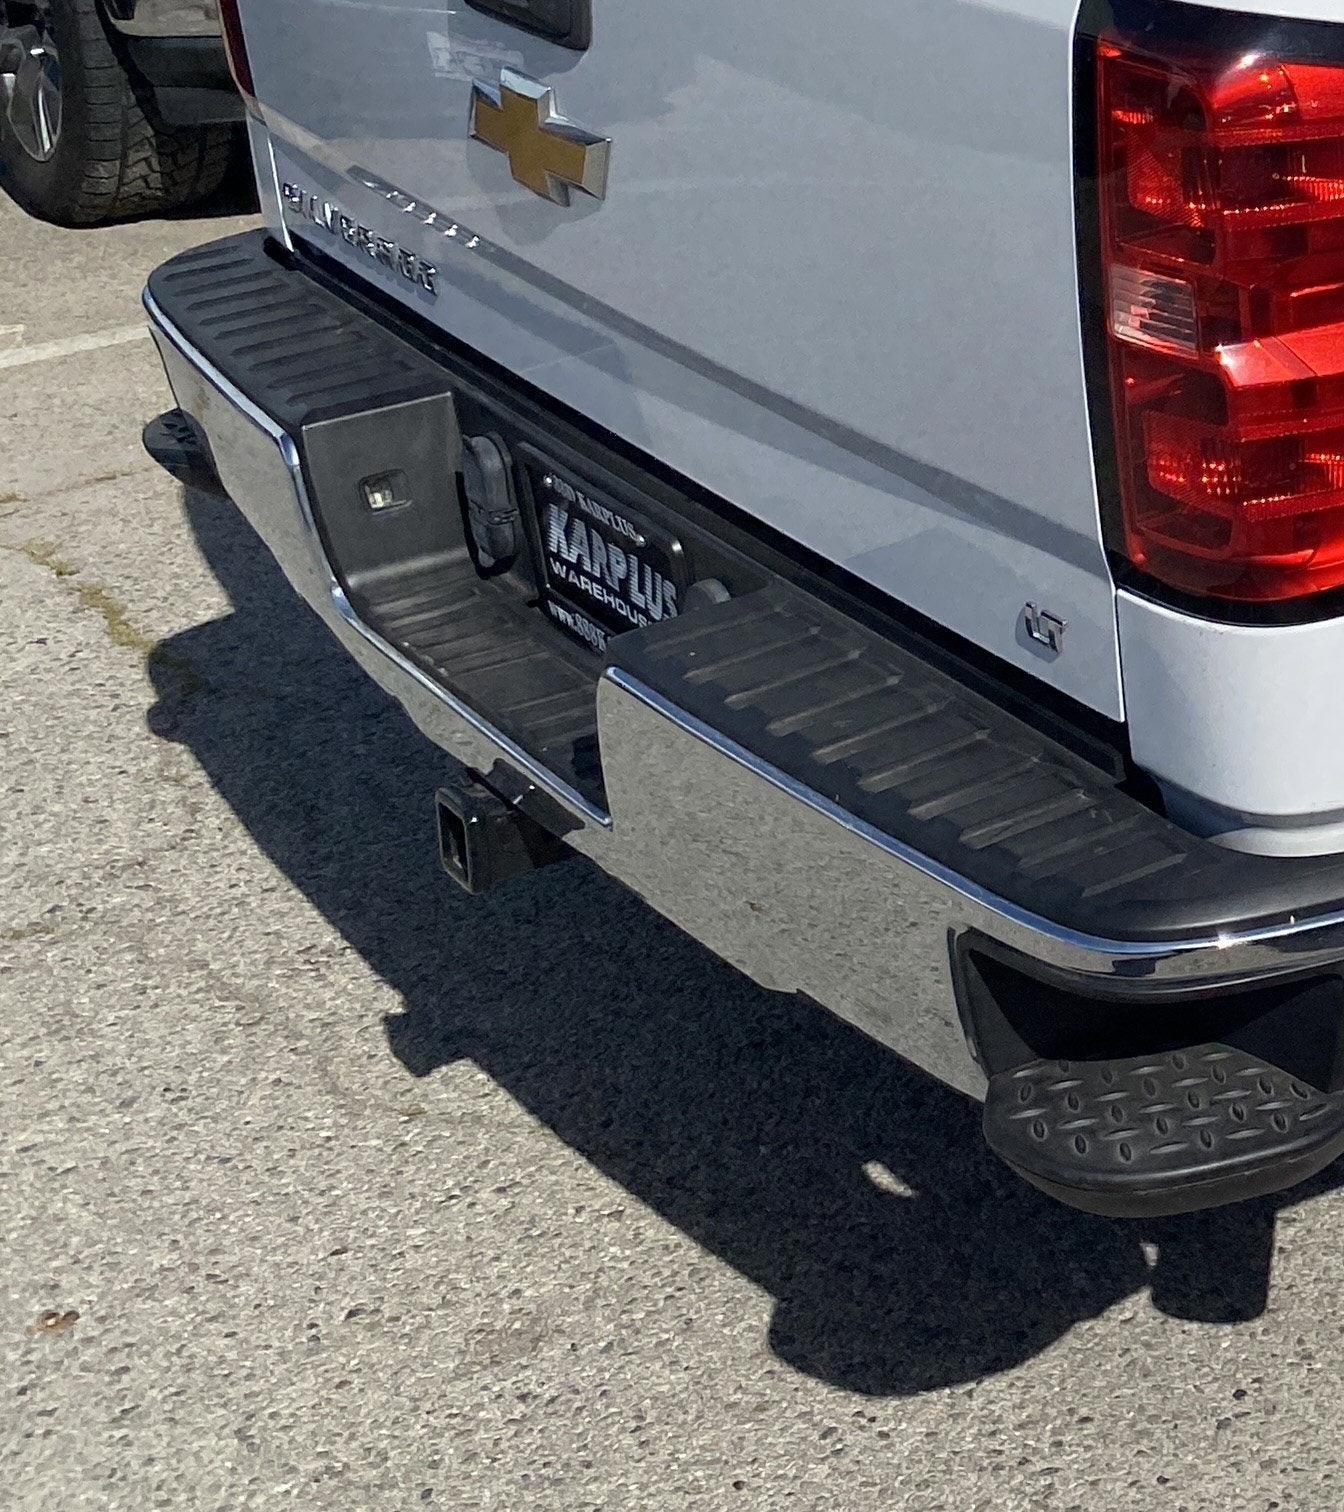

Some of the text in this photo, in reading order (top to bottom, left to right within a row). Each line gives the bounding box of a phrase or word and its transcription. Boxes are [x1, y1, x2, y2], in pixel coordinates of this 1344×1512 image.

[576, 490, 640, 540] KARPLUS
[548, 502, 679, 621] KARPLUS
[550, 557, 653, 628] WAREHOUS
[1024, 599, 1069, 654] LT
